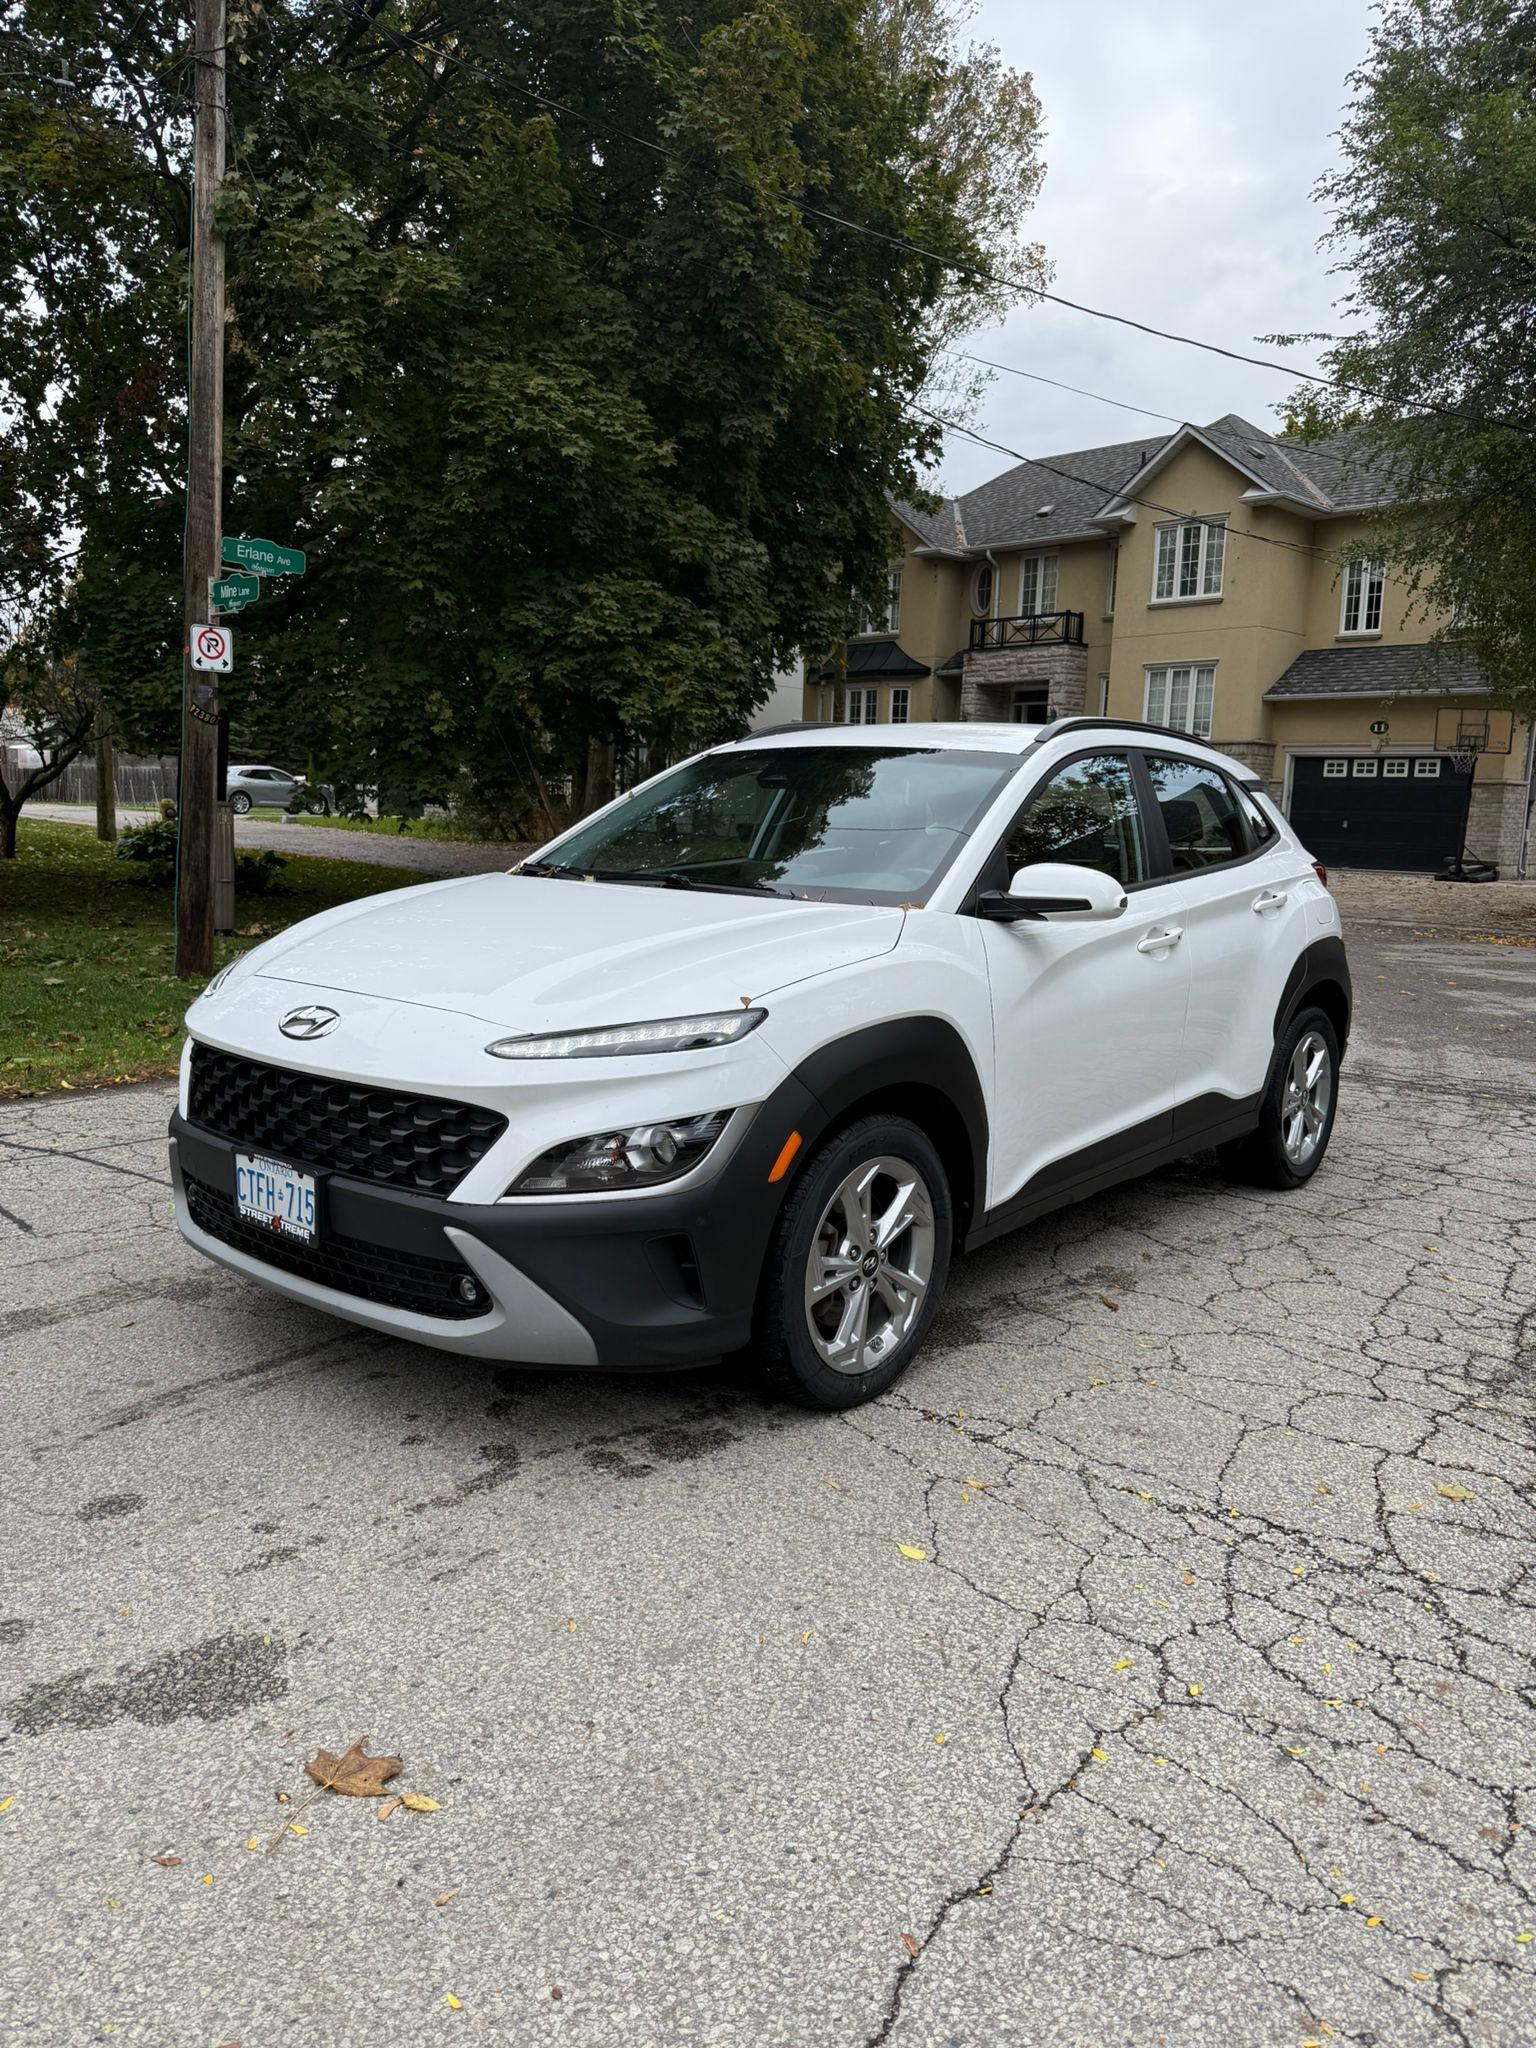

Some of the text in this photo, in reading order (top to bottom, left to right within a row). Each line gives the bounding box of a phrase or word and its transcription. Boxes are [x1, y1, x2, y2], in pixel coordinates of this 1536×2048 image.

[237, 544, 292, 566] Erlane Ave
[238, 587, 251, 597] Lane
[1373, 723, 1385, 732] 11
[237, 1167, 314, 1226] CTFH 715
